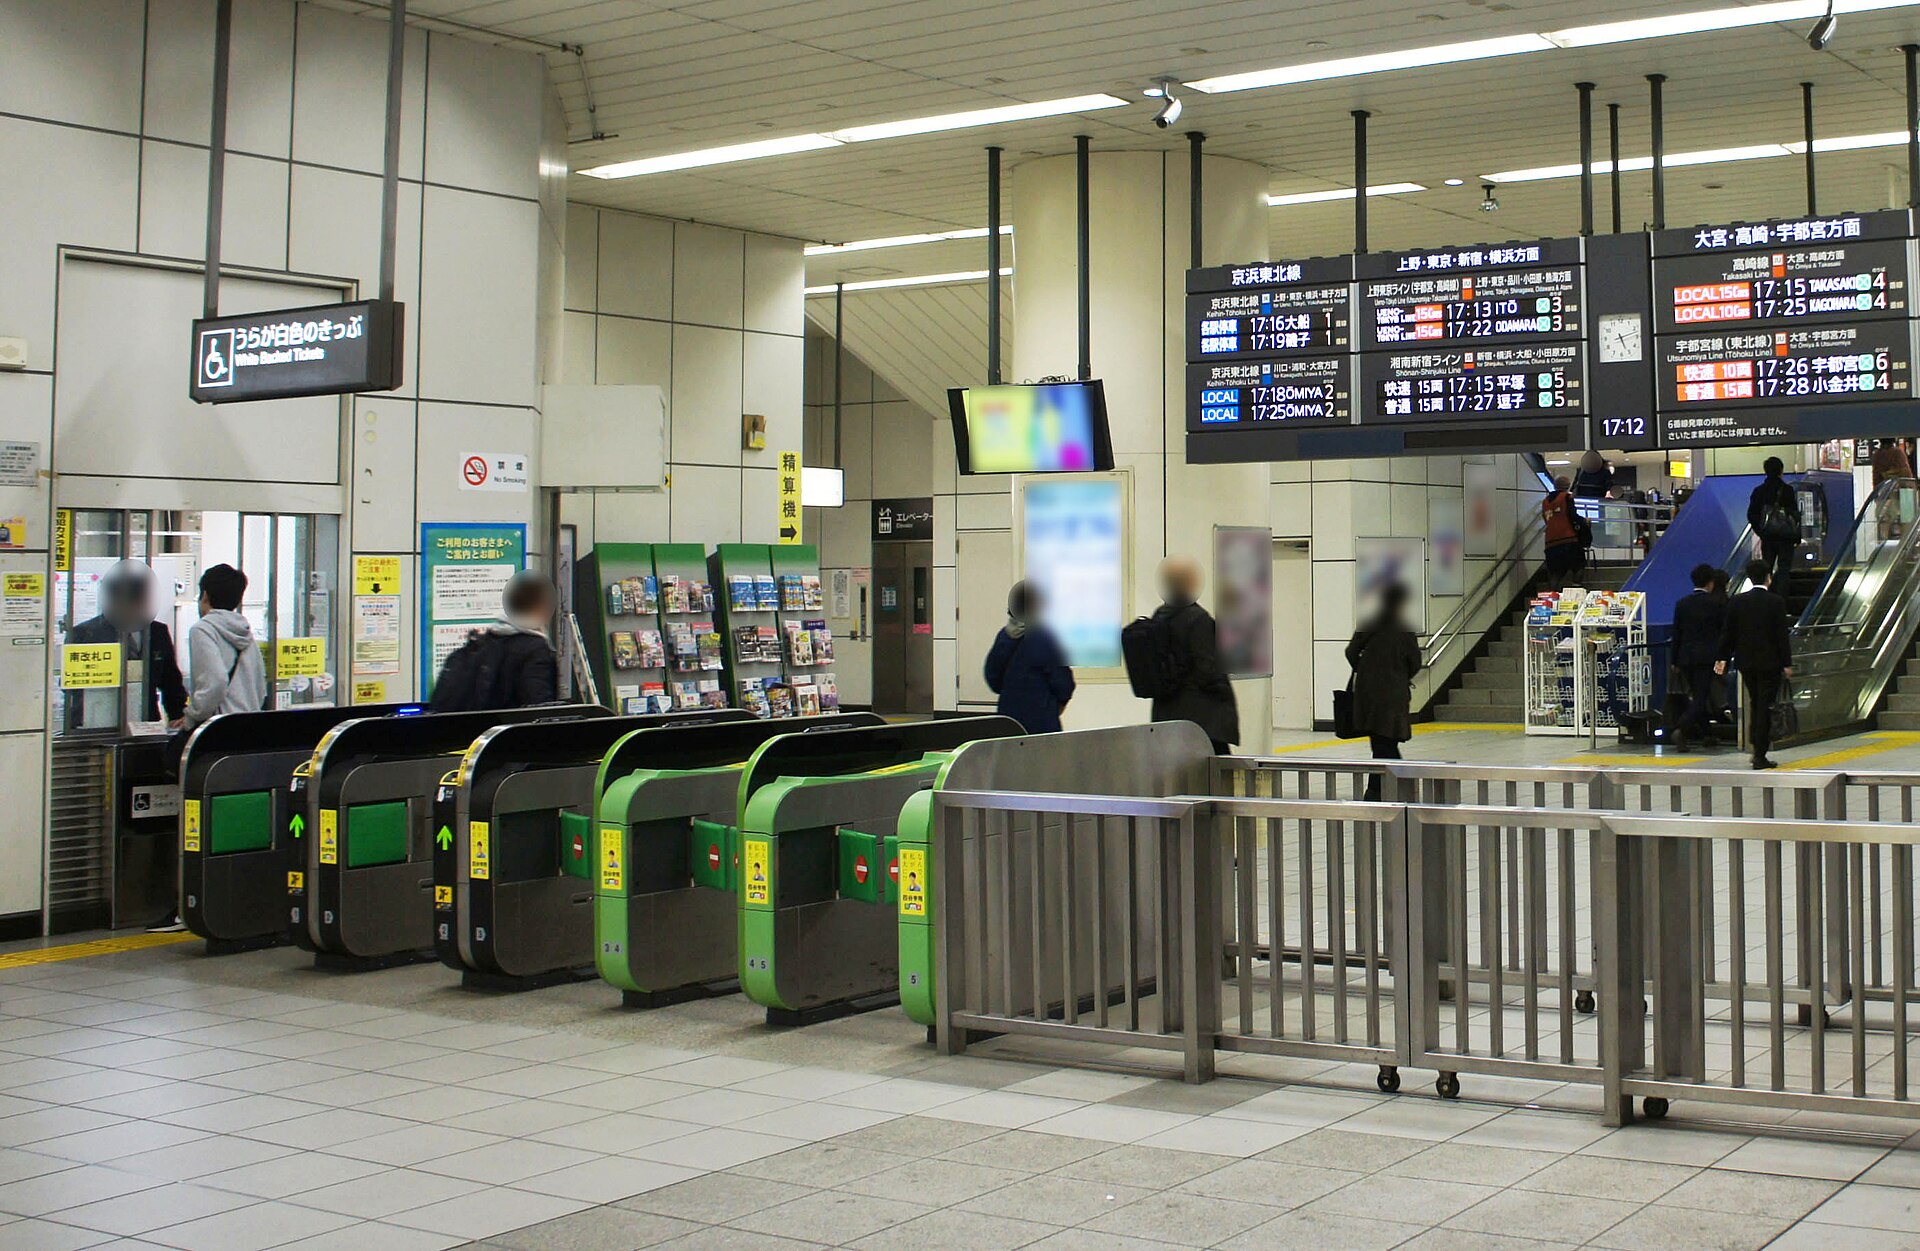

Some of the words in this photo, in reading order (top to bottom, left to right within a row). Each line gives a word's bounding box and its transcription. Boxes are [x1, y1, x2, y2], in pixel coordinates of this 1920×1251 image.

[1694, 218, 1861, 249] 大宮・高崎・宇都宮方面
[1396, 246, 1540, 272] 上野・東京・新宿・横浜方面
[1732, 256, 1769, 271] 高崎線
[1231, 264, 1301, 286] 京浜東北線
[1722, 271, 1753, 280] Takasaki
[1754, 270, 1770, 278] Line
[1674, 286, 1719, 304] LOCAL
[1754, 278, 1806, 299] 17:15
[1809, 276, 1857, 293] TAKASAKI
[1873, 272, 1886, 290] 4
[1211, 295, 1259, 310] 京浜東北線
[1447, 301, 1491, 319] 17:13
[1552, 297, 1562, 313] 3
[1675, 306, 1719, 322] LOCAL
[1755, 297, 1807, 318] 17:25
[1873, 292, 1886, 309] 4
[235, 314, 363, 351] うらが白色のきっぷ
[1250, 315, 1285, 333] 17:16
[1285, 313, 1310, 330] 大船
[1325, 312, 1331, 328] 1
[1447, 319, 1492, 338] 17:22
[1552, 315, 1562, 332] 3
[1250, 333, 1285, 351] 17:19
[1325, 330, 1331, 346] 1
[235, 351, 260, 367] White
[294, 347, 325, 362] Tickets
[1390, 354, 1461, 370] 湘南新宿ライン
[1667, 353, 1707, 363] Utsunomiya
[1708, 352, 1724, 360] Line
[1755, 348, 1773, 357] Line)
[1211, 365, 1259, 379] 京浜東北線
[1447, 367, 1462, 375] Line
[1683, 364, 1716, 382] 快速
[1722, 361, 1752, 379] 10両
[1757, 357, 1809, 378] 17:26
[1811, 355, 1859, 374] 宇都宮
[1876, 352, 1888, 370] 6
[1201, 390, 1238, 405] LOCAL
[1250, 386, 1286, 404] 17:18
[1286, 385, 1323, 401] ŌMIYA
[1325, 384, 1334, 400] 2
[1384, 380, 1412, 397] 快速
[1418, 379, 1444, 394] 15両
[1449, 375, 1494, 394] 17:15
[1497, 374, 1526, 391] 平塚
[1554, 372, 1564, 388] 5
[1684, 383, 1716, 400] 普通
[1722, 381, 1752, 398] 15両
[1757, 377, 1810, 398] 17:28
[1812, 374, 1860, 394] 小金井
[1876, 372, 1889, 390] 4
[1201, 407, 1238, 421] LOCAL
[1250, 403, 1286, 421] 17:25
[1286, 403, 1323, 418] ŌMIYA
[1325, 402, 1334, 418] 2
[1384, 398, 1412, 415] 普通
[1418, 397, 1444, 412] 15両
[1449, 394, 1495, 412] 17:27
[1497, 393, 1526, 410] 逗子
[1554, 390, 1565, 407] 5
[1603, 417, 1644, 436] 17:12
[782, 453, 796, 518] 精算機
[69, 651, 111, 662] 南改札口
[282, 645, 317, 655] 南改札口
[749, 959, 755, 969] 4
[760, 960, 767, 970] 5
[910, 975, 917, 985] 5
